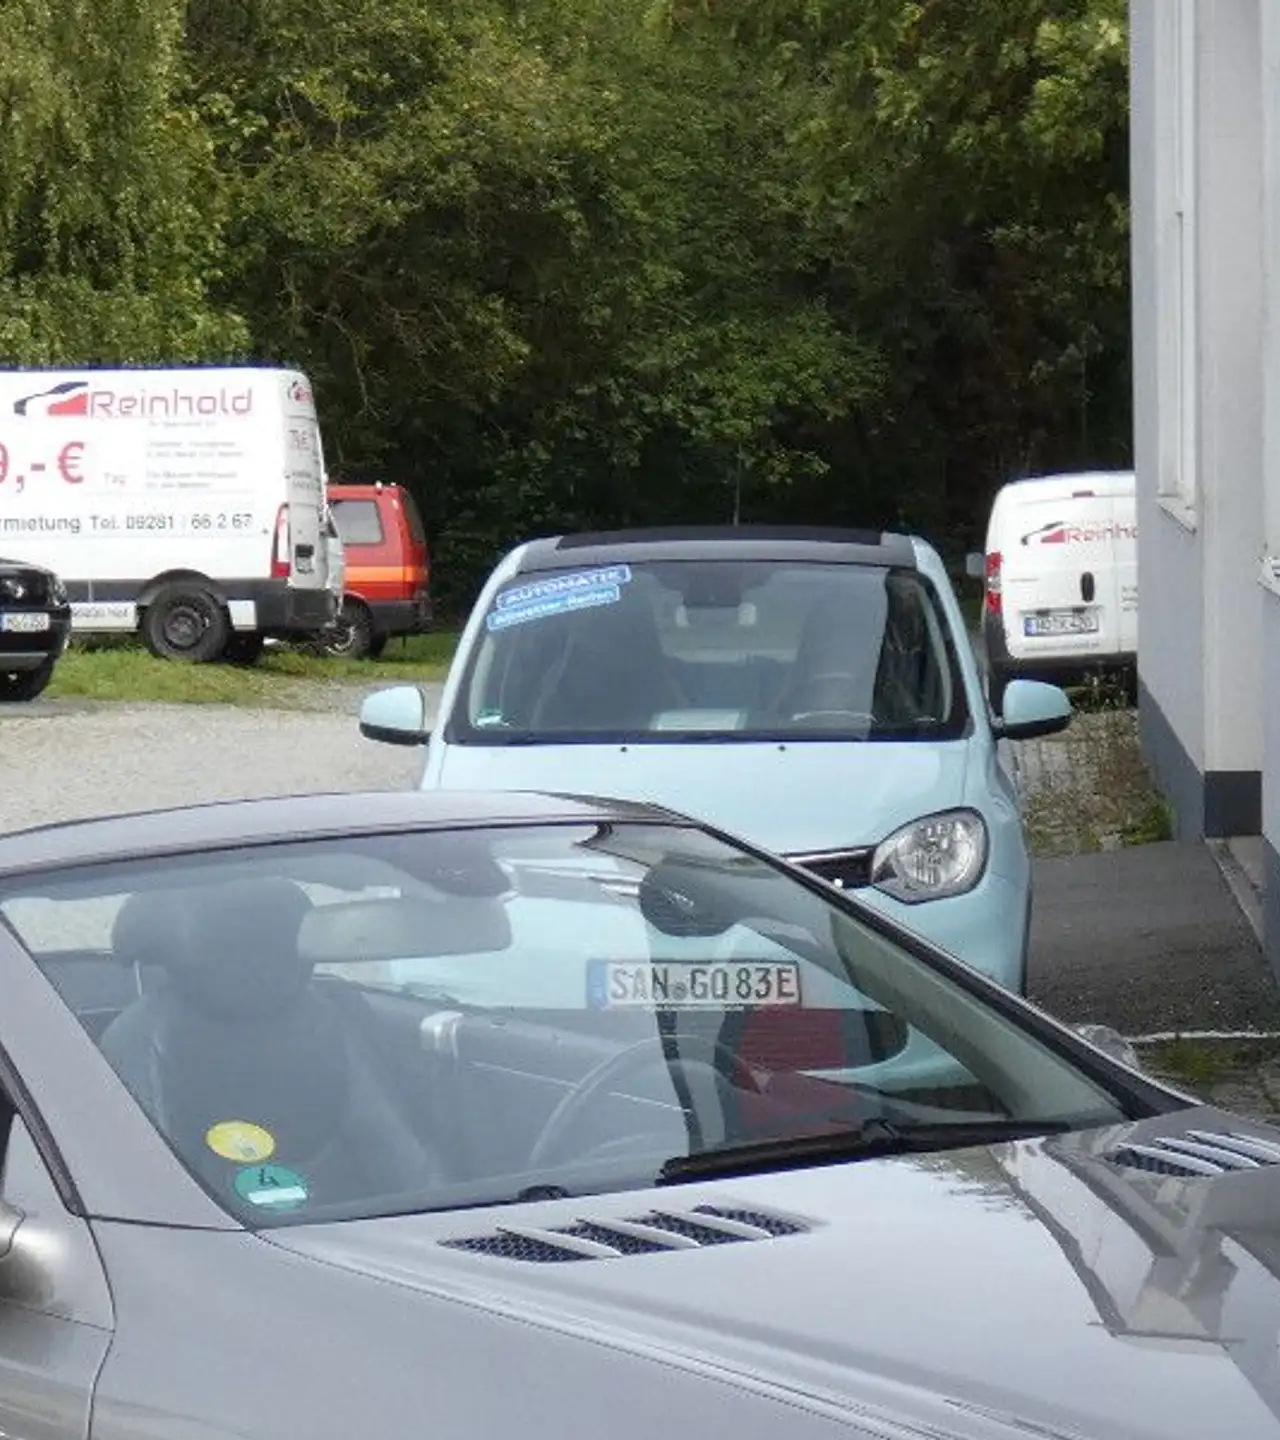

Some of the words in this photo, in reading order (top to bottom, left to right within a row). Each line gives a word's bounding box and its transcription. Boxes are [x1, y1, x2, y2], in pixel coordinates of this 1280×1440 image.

[89, 388, 253, 416] Reinhold
[57, 441, 85, 484] €
[89, 515, 120, 530] Tel.
[217, 513, 227, 530] 2
[232, 513, 253, 530] 67
[610, 966, 670, 1000] SAN
